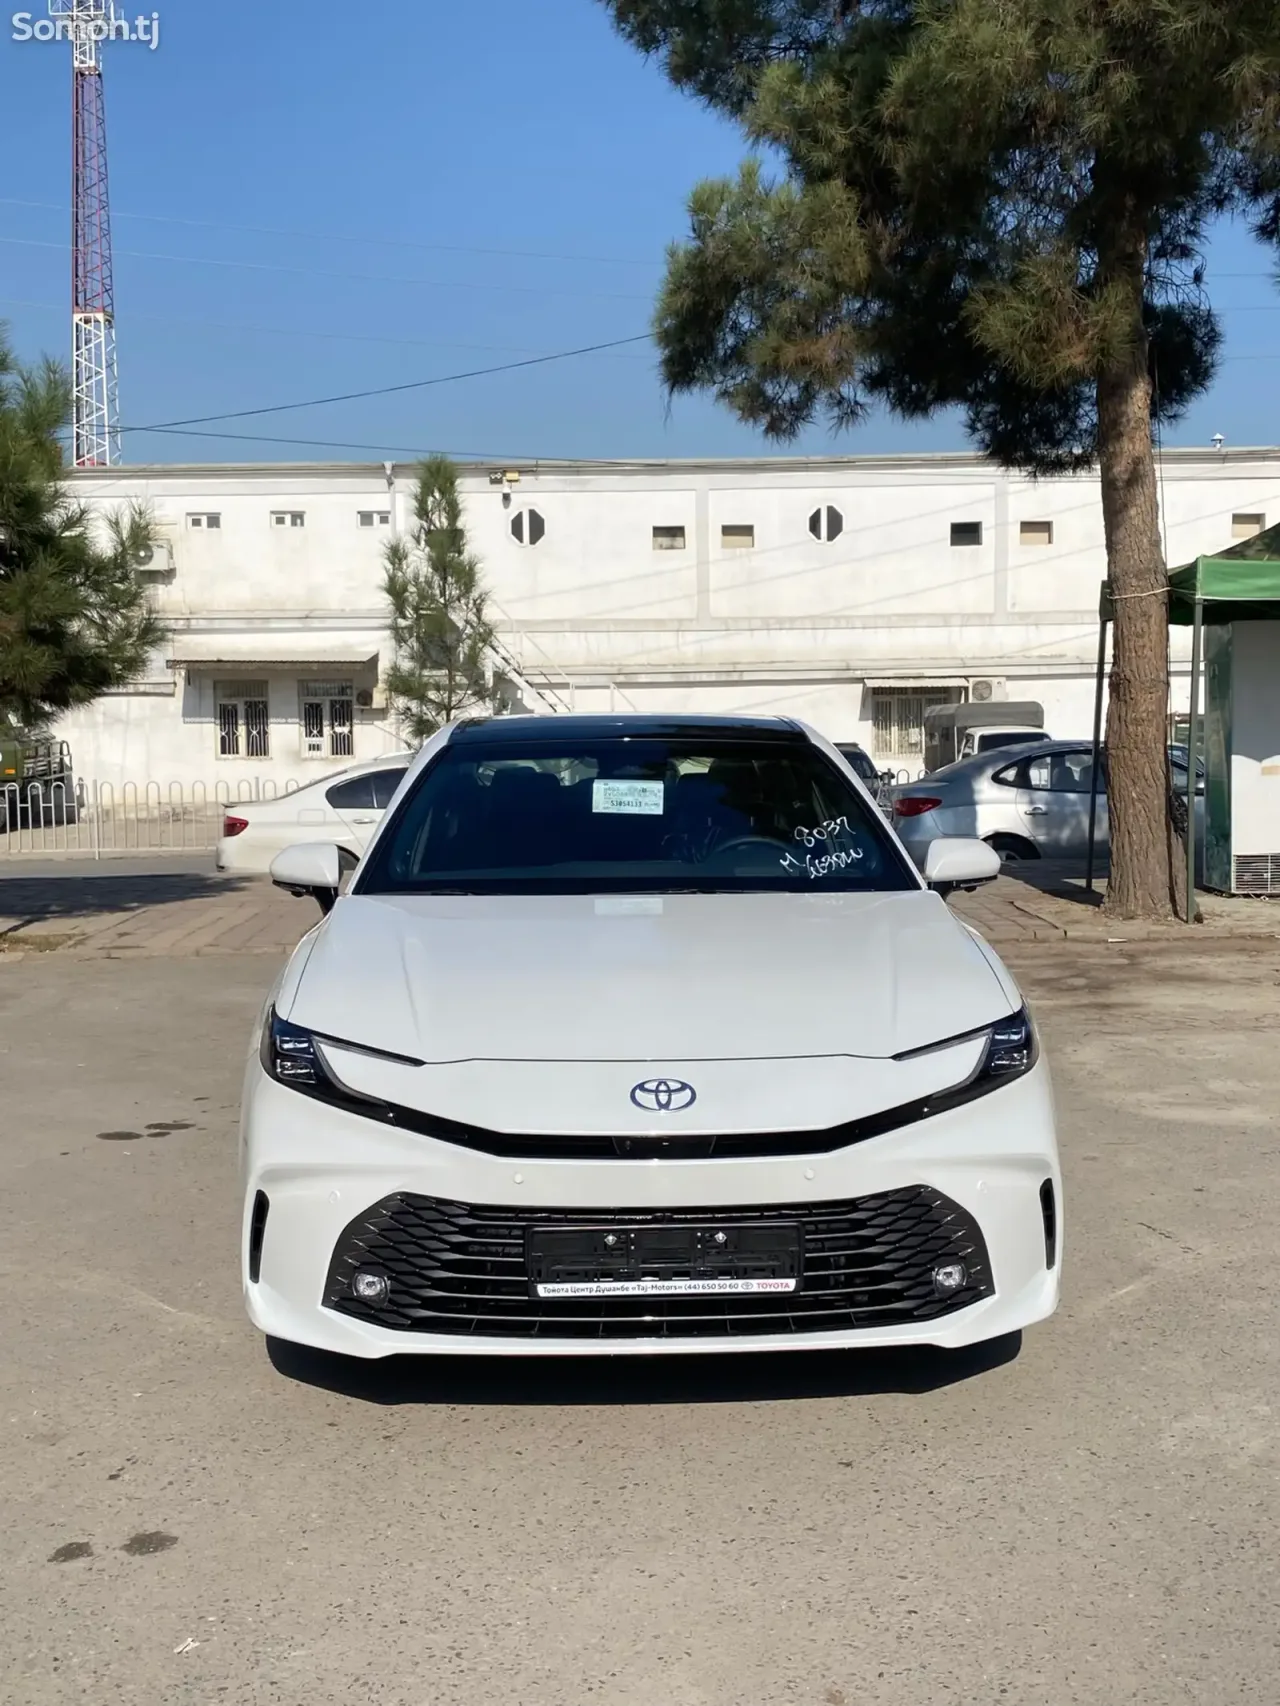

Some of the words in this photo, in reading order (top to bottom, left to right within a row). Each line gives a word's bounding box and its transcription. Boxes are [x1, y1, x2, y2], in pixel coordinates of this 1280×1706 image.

[794, 816, 856, 847] 8037
[570, 1285, 594, 1294] Центр
[594, 1285, 630, 1294] Душанбе
[683, 1283, 701, 1292] (44)
[718, 1282, 728, 1290] 50
[728, 1282, 739, 1290] 60
[756, 1282, 791, 1290] TOYOTA
